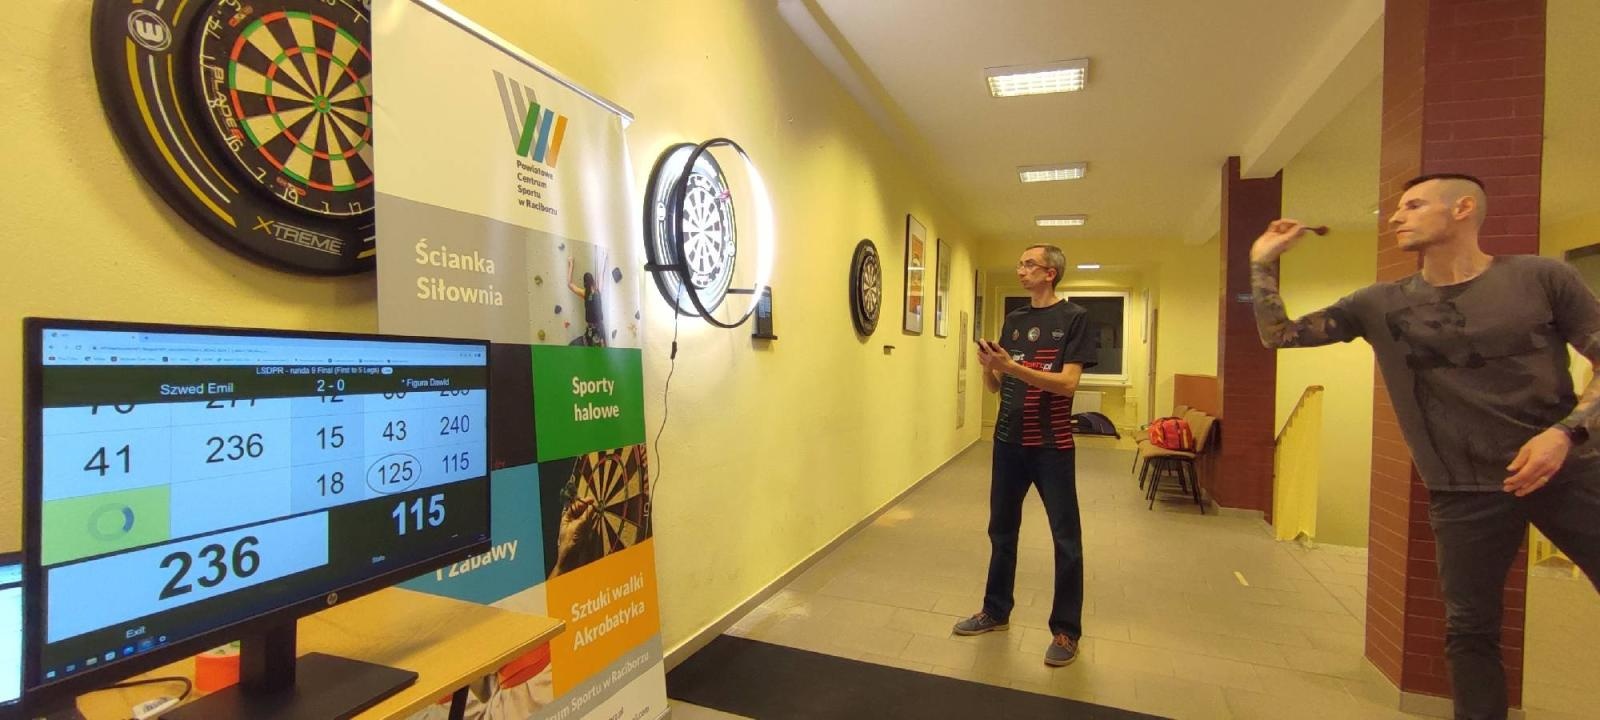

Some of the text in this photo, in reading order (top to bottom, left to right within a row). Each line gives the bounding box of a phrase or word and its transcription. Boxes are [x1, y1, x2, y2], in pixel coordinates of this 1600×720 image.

[516, 159, 554, 181] Powiatowe
[516, 172, 548, 189] Centrum
[517, 184, 542, 199] Sportu
[526, 199, 558, 216] Raciborzu
[252, 215, 345, 255] XTREME
[415, 238, 496, 275] Ścianka
[417, 276, 503, 306] Siłownia
[256, 366, 285, 376] LSDPR
[160, 382, 234, 396] Szwed Emil
[316, 379, 326, 392] 2
[336, 378, 345, 392] 0
[406, 377, 450, 389] Figura Dawid
[572, 376, 615, 398] Sporty
[574, 402, 620, 422] halowe
[382, 420, 407, 442] 43
[440, 414, 470, 436] 240
[206, 432, 264, 464] 236
[316, 425, 345, 450] 15
[83, 443, 132, 477] 41
[442, 451, 470, 474] 115
[316, 471, 345, 497] 18
[377, 460, 414, 486] 125
[392, 493, 446, 536] 115
[158, 535, 261, 601] 236
[571, 572, 645, 623] Sztuki walki
[125, 626, 146, 639] Exit
[573, 601, 646, 652] Akrobatyka
[571, 681, 602, 712] Sportu
[611, 651, 650, 682] Raciborzu
